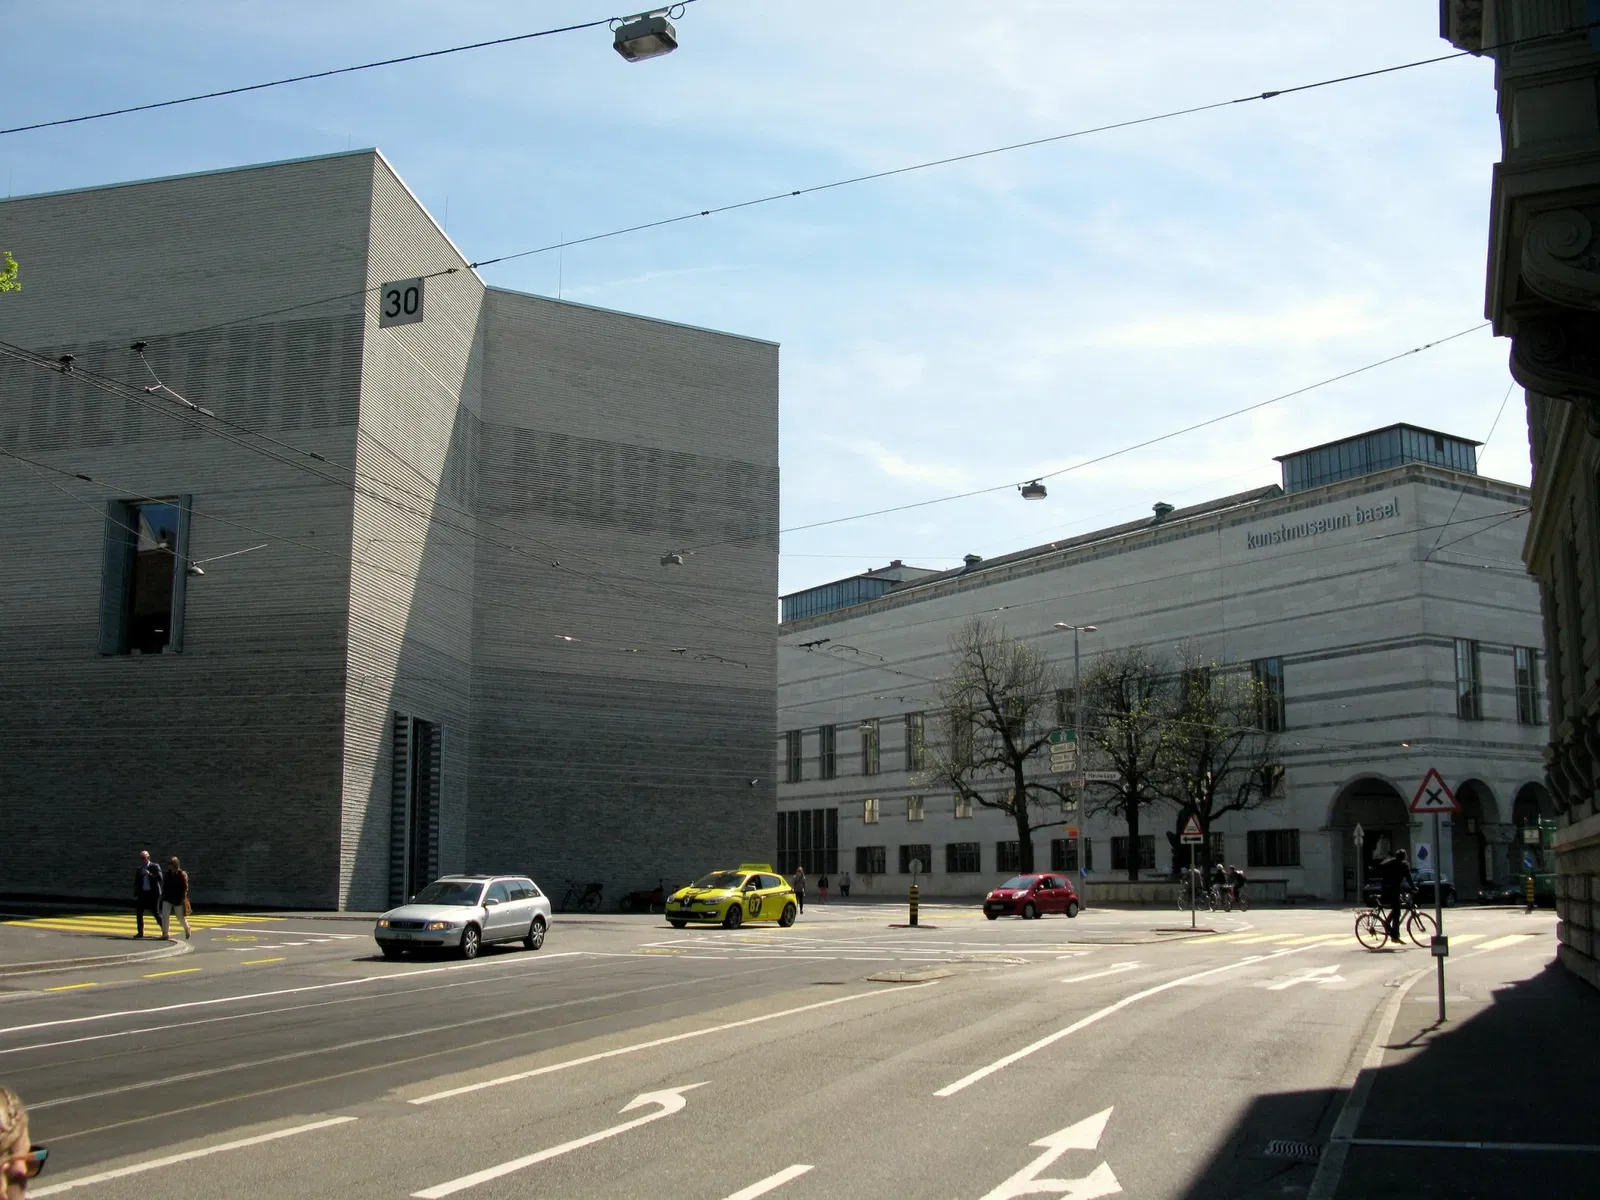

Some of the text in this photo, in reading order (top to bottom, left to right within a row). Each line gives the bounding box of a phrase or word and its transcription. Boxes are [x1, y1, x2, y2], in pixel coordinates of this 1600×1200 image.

[385, 287, 419, 318] 30
[1247, 497, 1401, 549] kunstmuseum basel
[750, 896, 761, 913] 87
